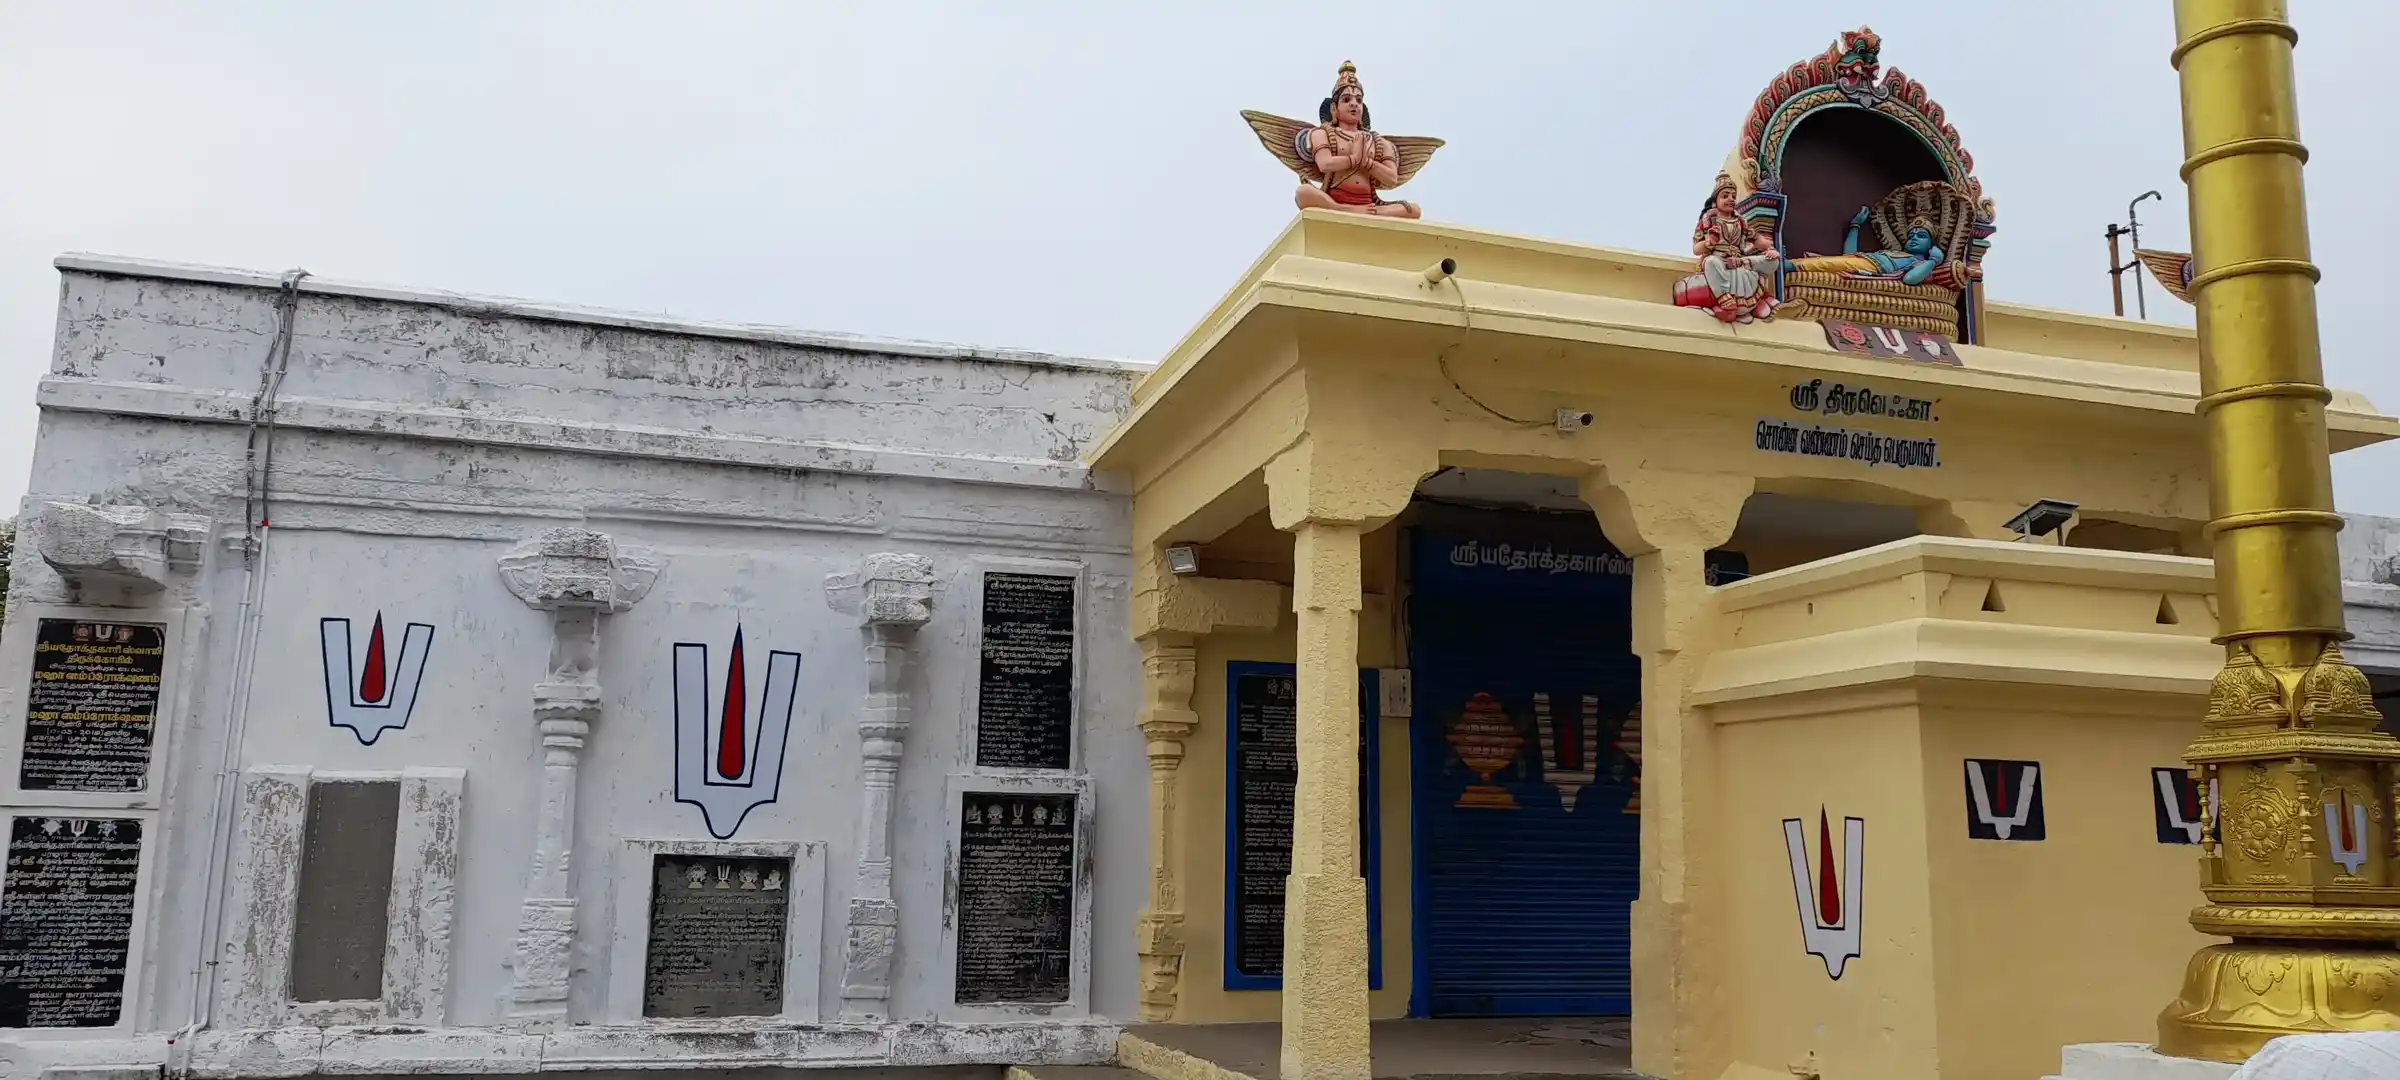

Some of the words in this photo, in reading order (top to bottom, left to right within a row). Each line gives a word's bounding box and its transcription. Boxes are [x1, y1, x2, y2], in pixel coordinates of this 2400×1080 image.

[1790, 379, 1822, 412] ஸ்ரீ
[1757, 420, 1799, 453] சொன்ன
[1800, 426, 1848, 459] வண்ணம்
[1850, 432, 1881, 467] செய்த
